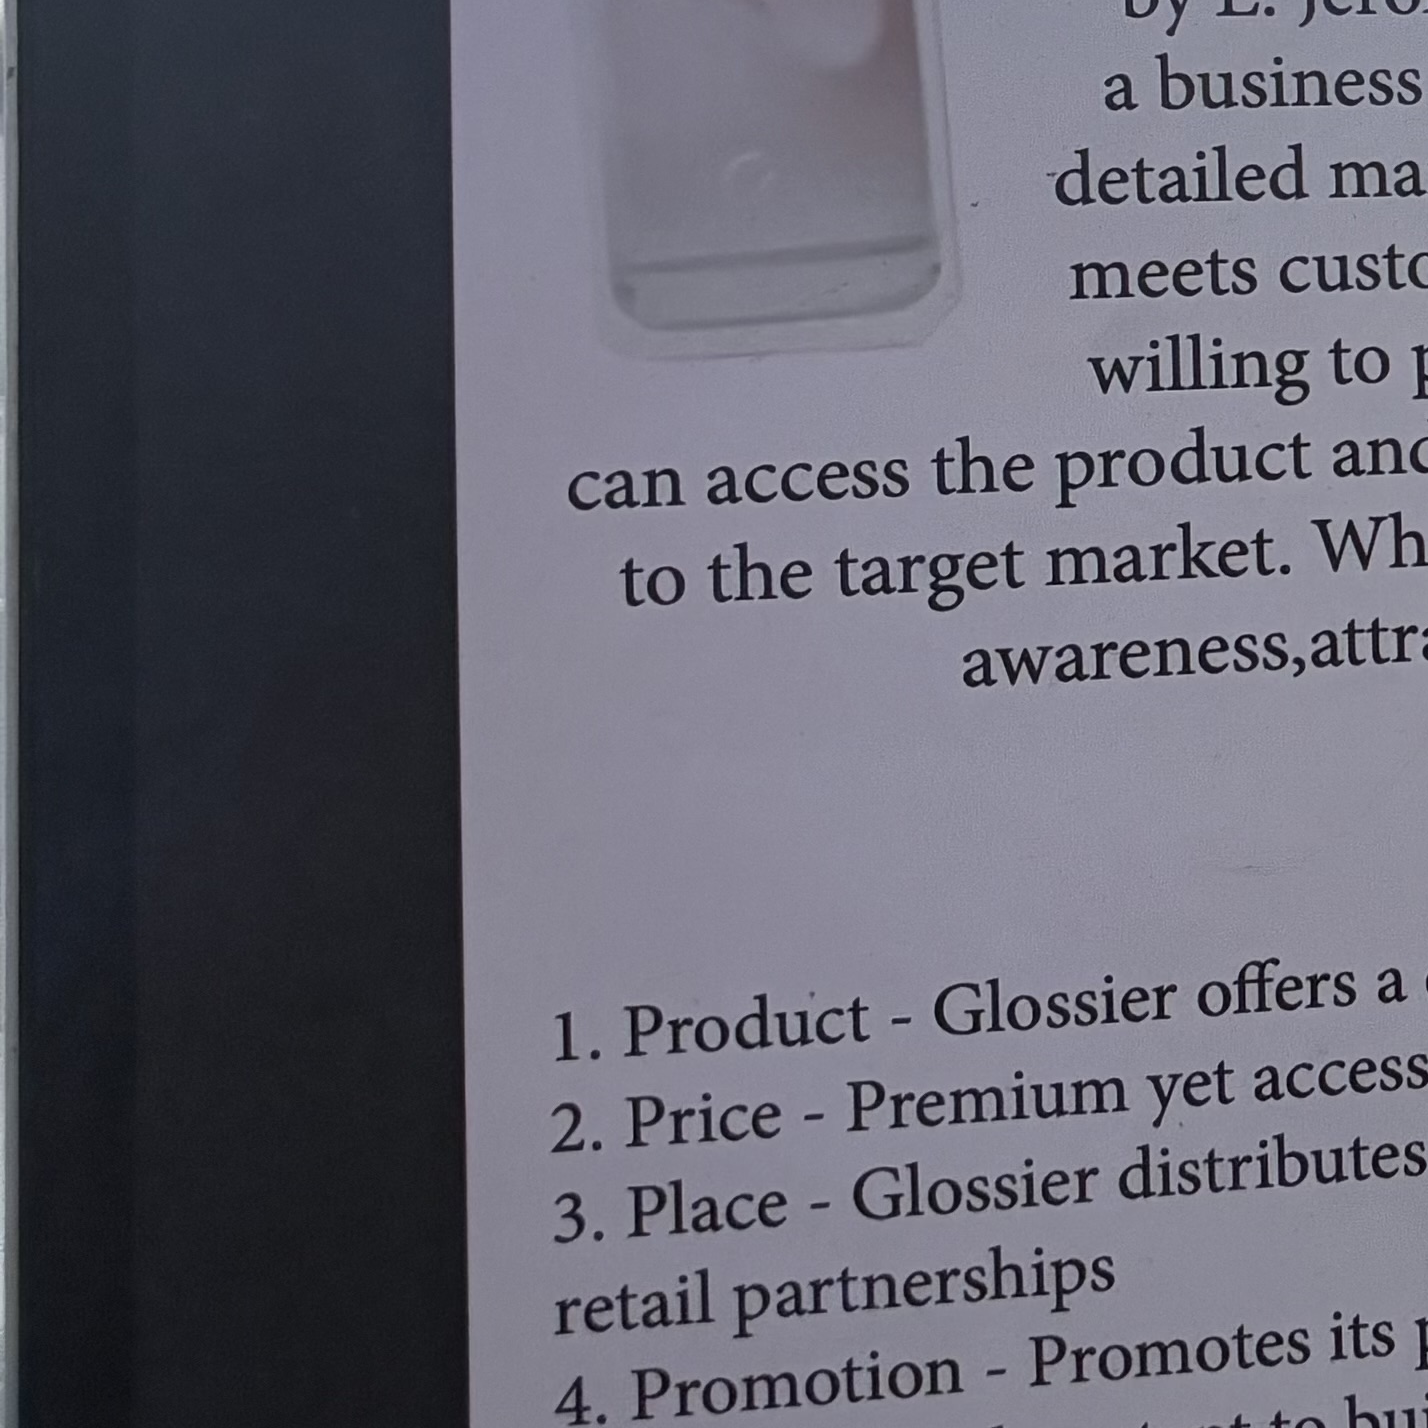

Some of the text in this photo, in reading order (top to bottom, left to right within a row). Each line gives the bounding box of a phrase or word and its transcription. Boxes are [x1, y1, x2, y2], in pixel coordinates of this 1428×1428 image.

[1055, 143, 1309, 206] detailed
[1087, 333, 1310, 406] willing
[1328, 338, 1390, 385] to
[620, 558, 685, 607] to
[707, 542, 812, 603] the
[834, 541, 1025, 612] target
[1045, 521, 1290, 586] market.
[555, 1012, 600, 1061] 1.
[624, 993, 870, 1057] Product
[934, 975, 1177, 1035] Glossier
[1198, 957, 1356, 1017] offers
[1378, 968, 1408, 1004] a
[551, 1103, 602, 1153] 2.
[626, 1093, 781, 1147] Price
[847, 1071, 1129, 1132] Premium
[1146, 1060, 1235, 1128] yet
[555, 1245, 1115, 1339] retail partnerships
